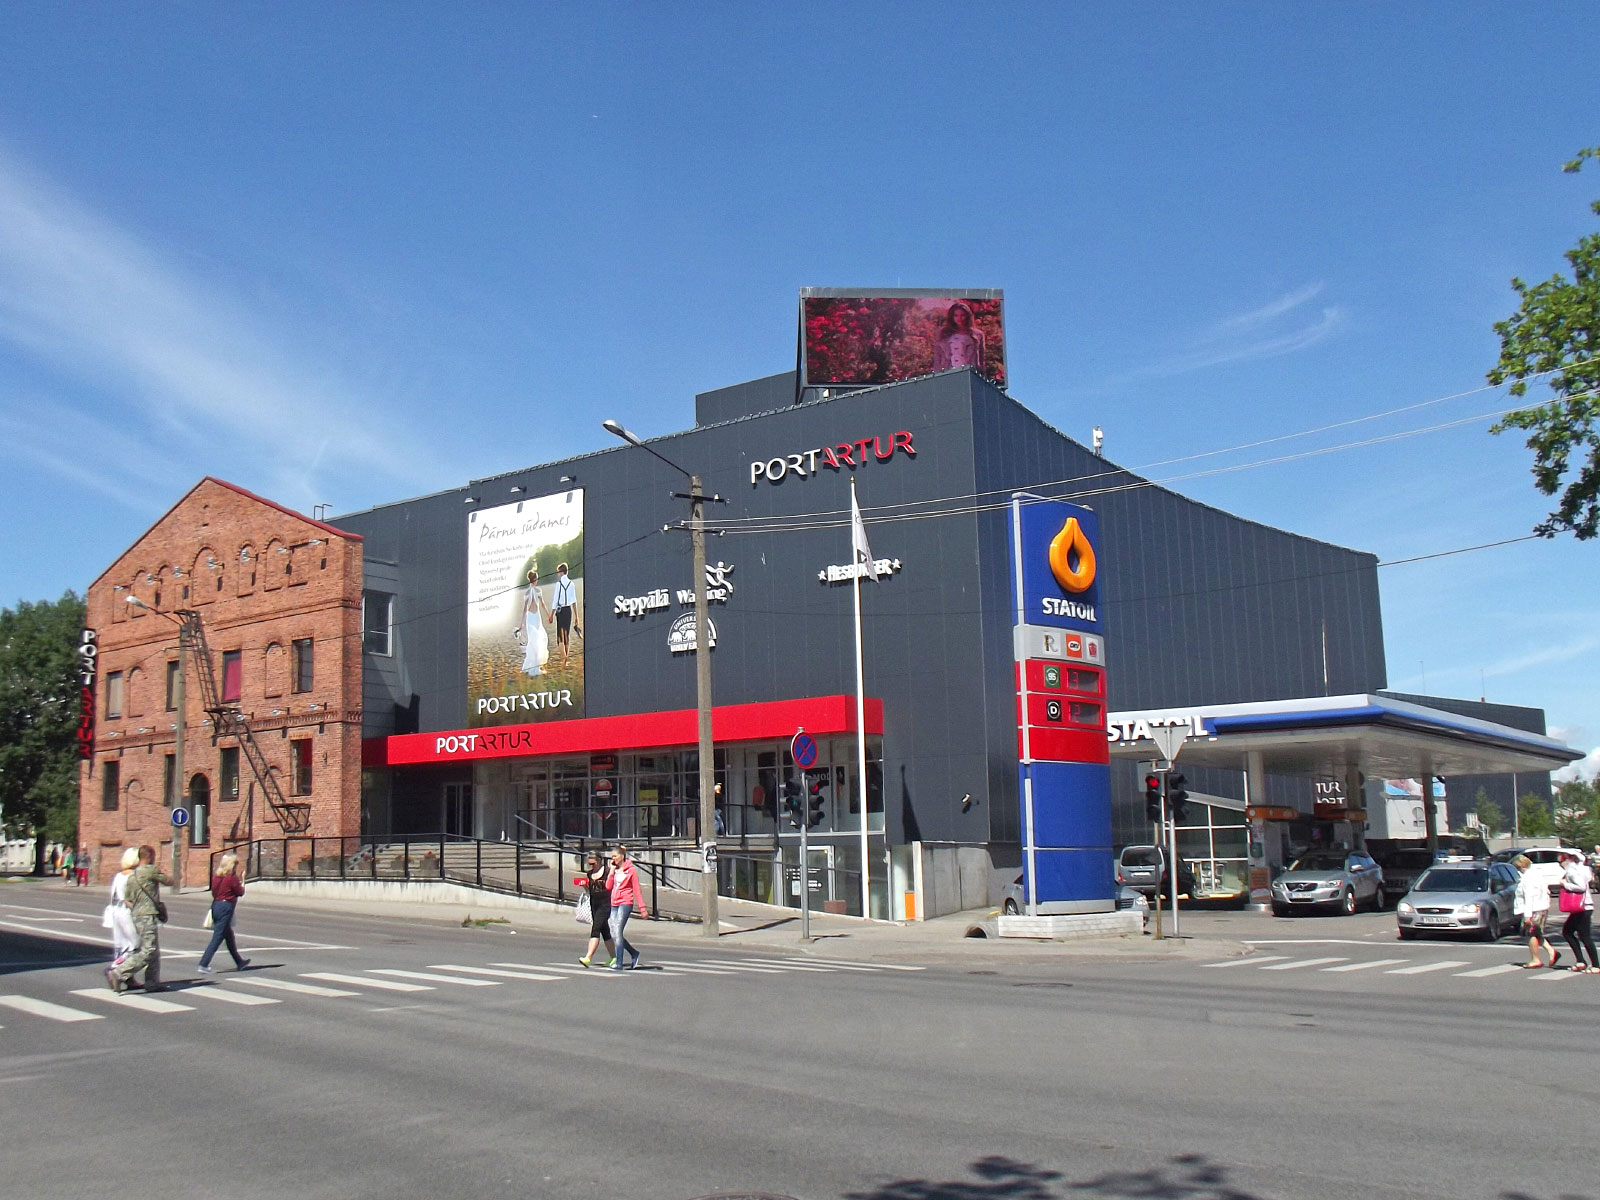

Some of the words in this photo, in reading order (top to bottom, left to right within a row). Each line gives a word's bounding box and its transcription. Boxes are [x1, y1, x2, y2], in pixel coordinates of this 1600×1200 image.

[676, 586, 728, 604] Waing
[1042, 597, 1097, 622] STATOIL
[478, 690, 573, 715] PORTARTUR
[1050, 705, 1058, 715] D
[436, 731, 533, 754] PORTARTUR
